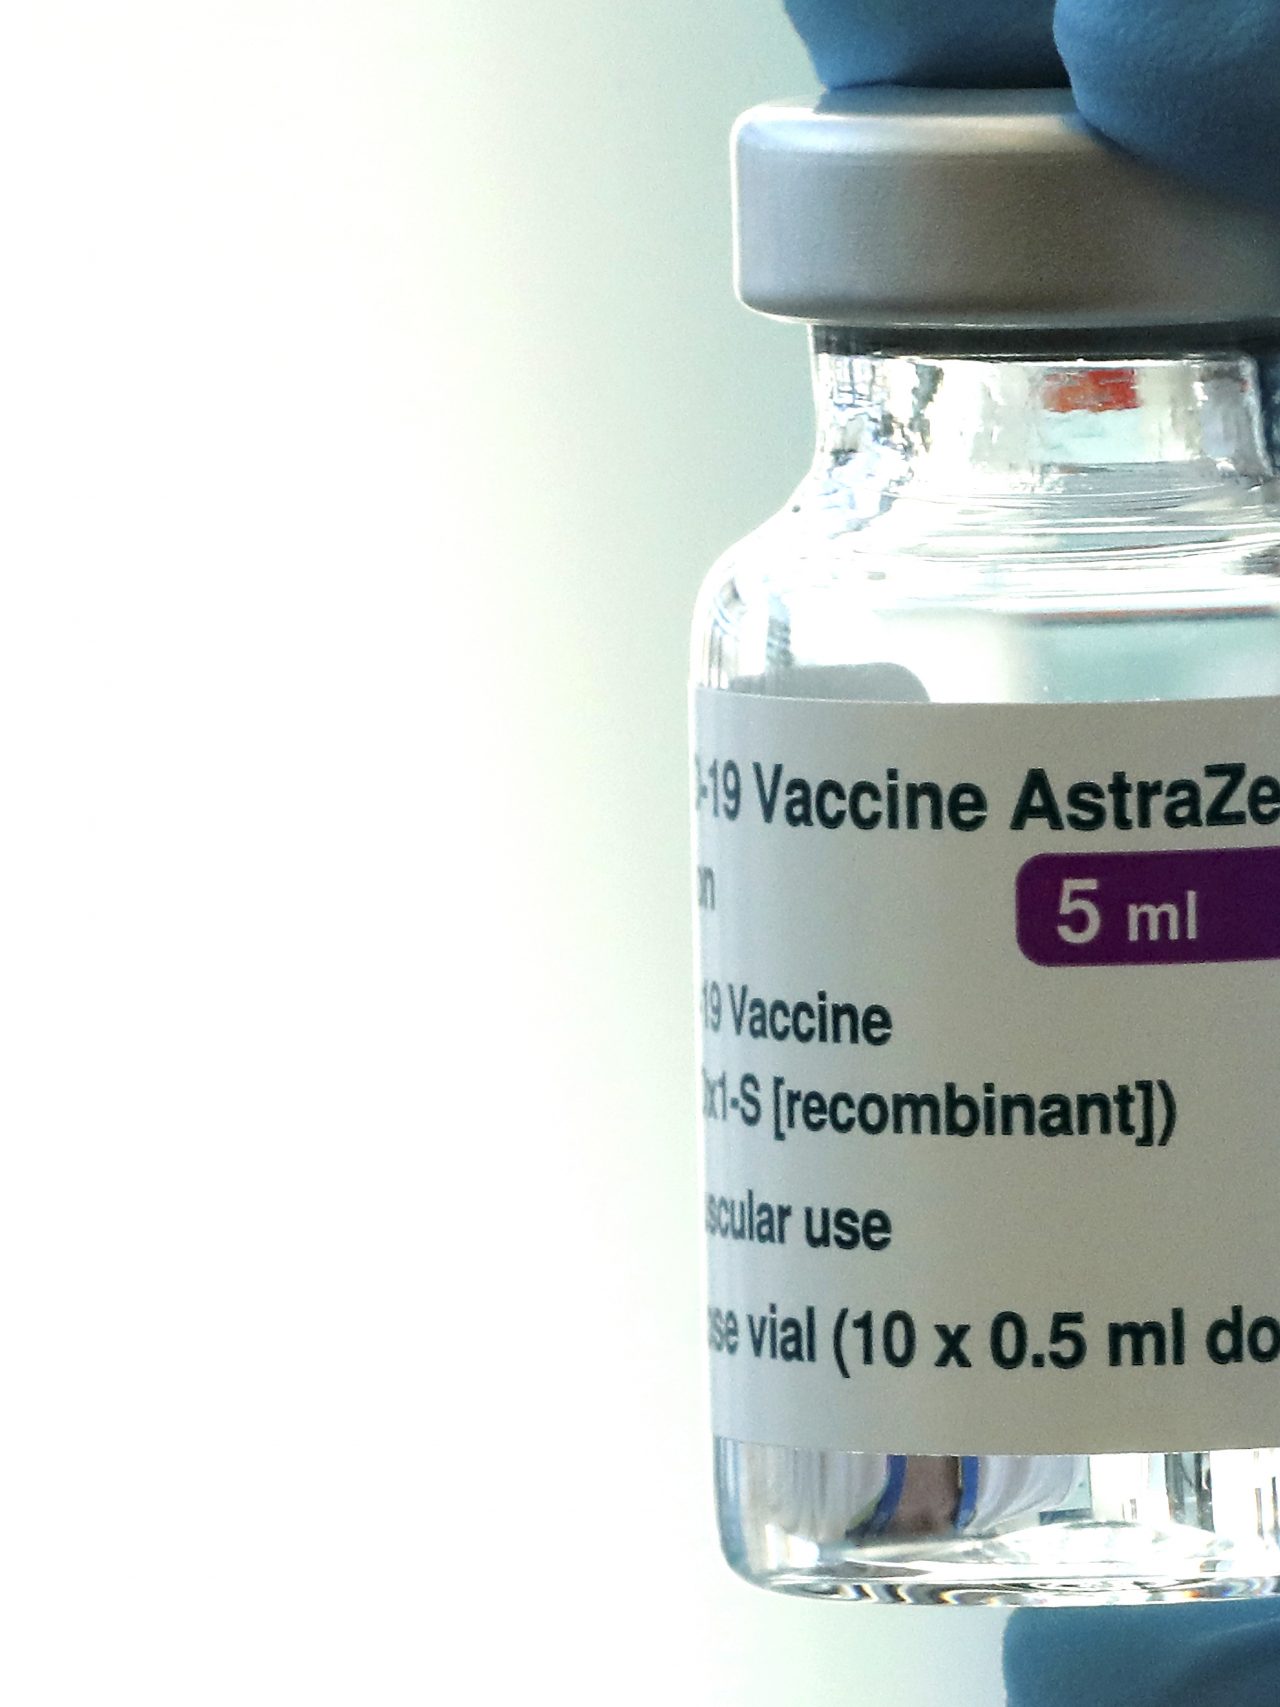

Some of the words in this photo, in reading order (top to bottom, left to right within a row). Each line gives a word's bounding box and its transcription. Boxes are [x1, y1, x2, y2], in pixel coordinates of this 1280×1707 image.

[695, 754, 742, 822] -19
[753, 761, 988, 833] Vaccine
[1057, 878, 1100, 944] 5
[1128, 890, 1196, 941] ml
[727, 983, 893, 1047] Vaccine
[702, 1065, 762, 1128] x1-S
[773, 1075, 1177, 1148] [recombinant])
[705, 1188, 792, 1245] scular
[804, 1206, 892, 1251] use
[707, 1305, 741, 1356] se
[748, 1303, 816, 1362] vial
[833, 1307, 916, 1379] (10
[933, 1324, 972, 1368] x
[989, 1310, 1088, 1371] 0.5
[1107, 1306, 1186, 1367] ml
